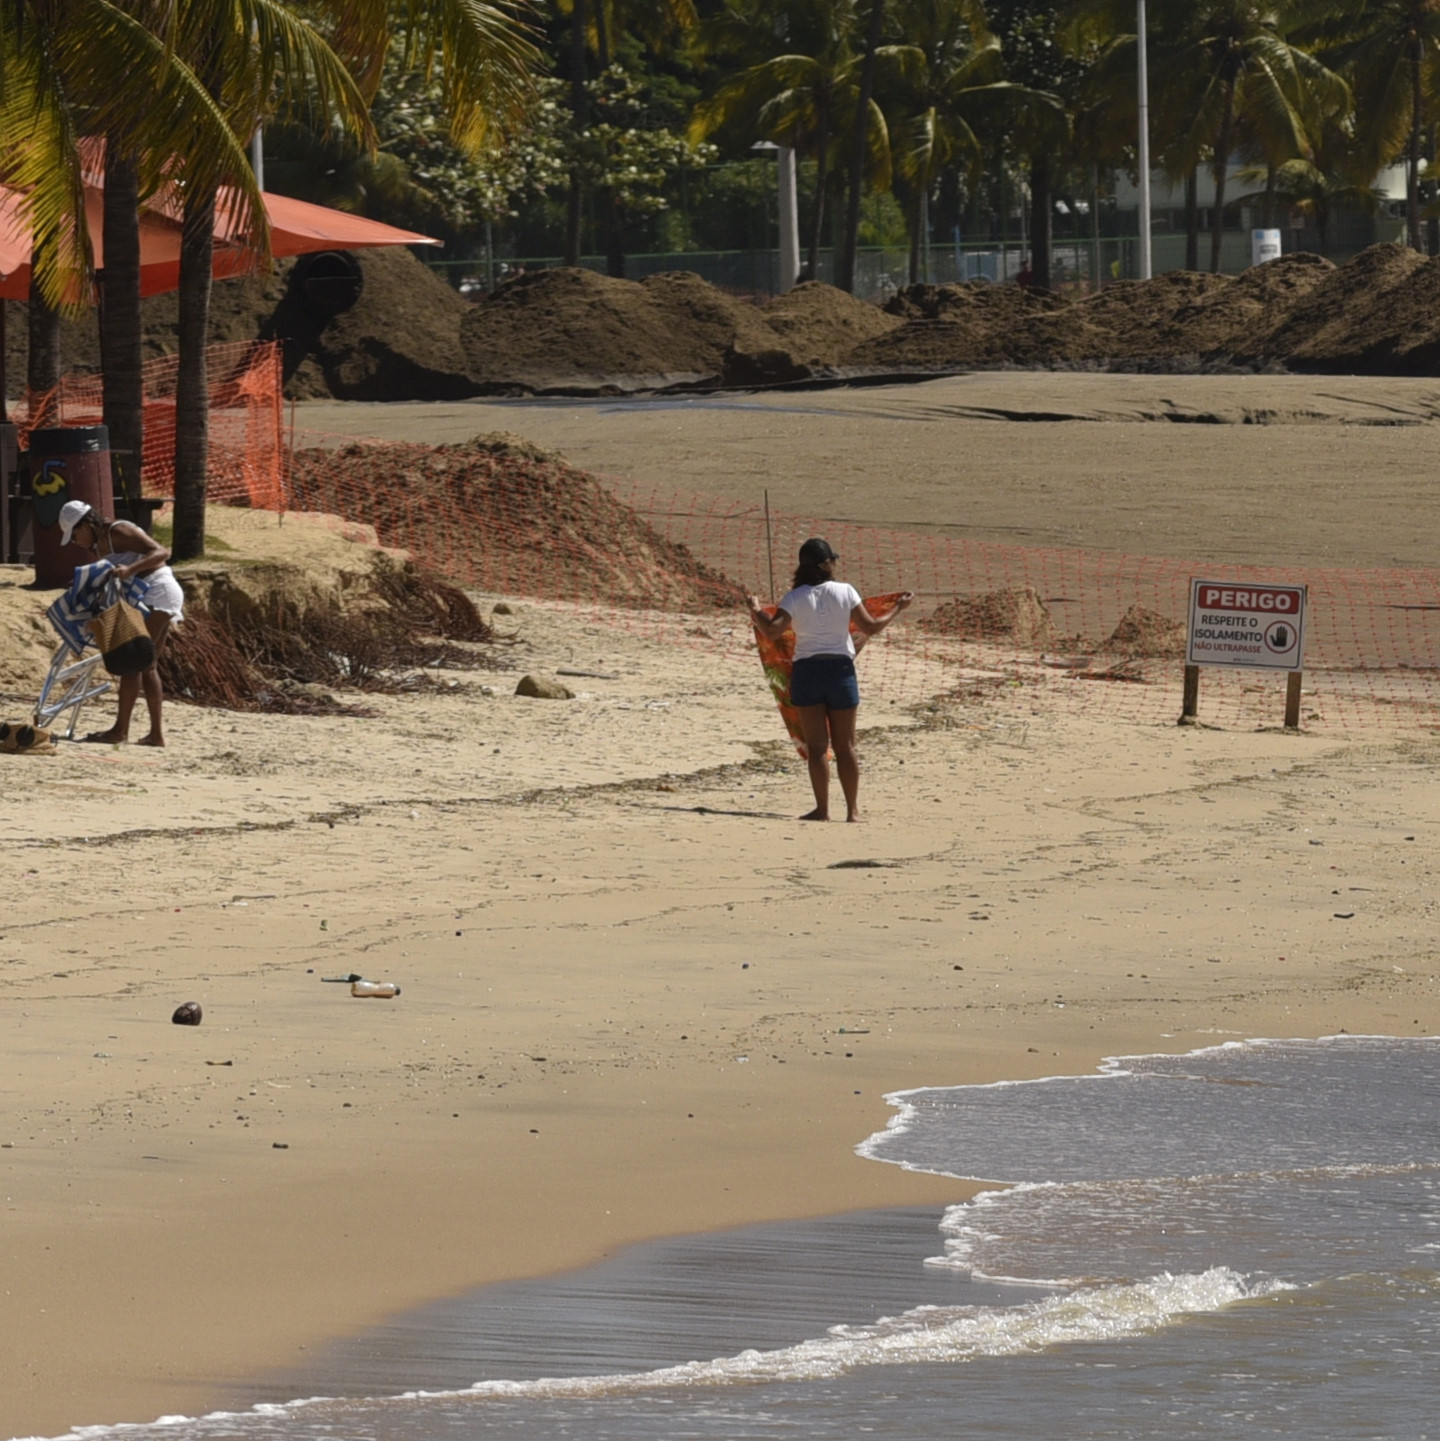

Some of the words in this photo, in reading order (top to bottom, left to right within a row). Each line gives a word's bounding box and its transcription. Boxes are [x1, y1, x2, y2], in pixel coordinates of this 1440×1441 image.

[1206, 589, 1291, 610] PERIGO
[1201, 614, 1247, 627] RESPEITE
[1249, 618, 1258, 627] O
[1195, 629, 1263, 642] ISOLAMENTO
[1194, 641, 1212, 651] NÃO
[1213, 643, 1262, 654] ULTRAPASSE
